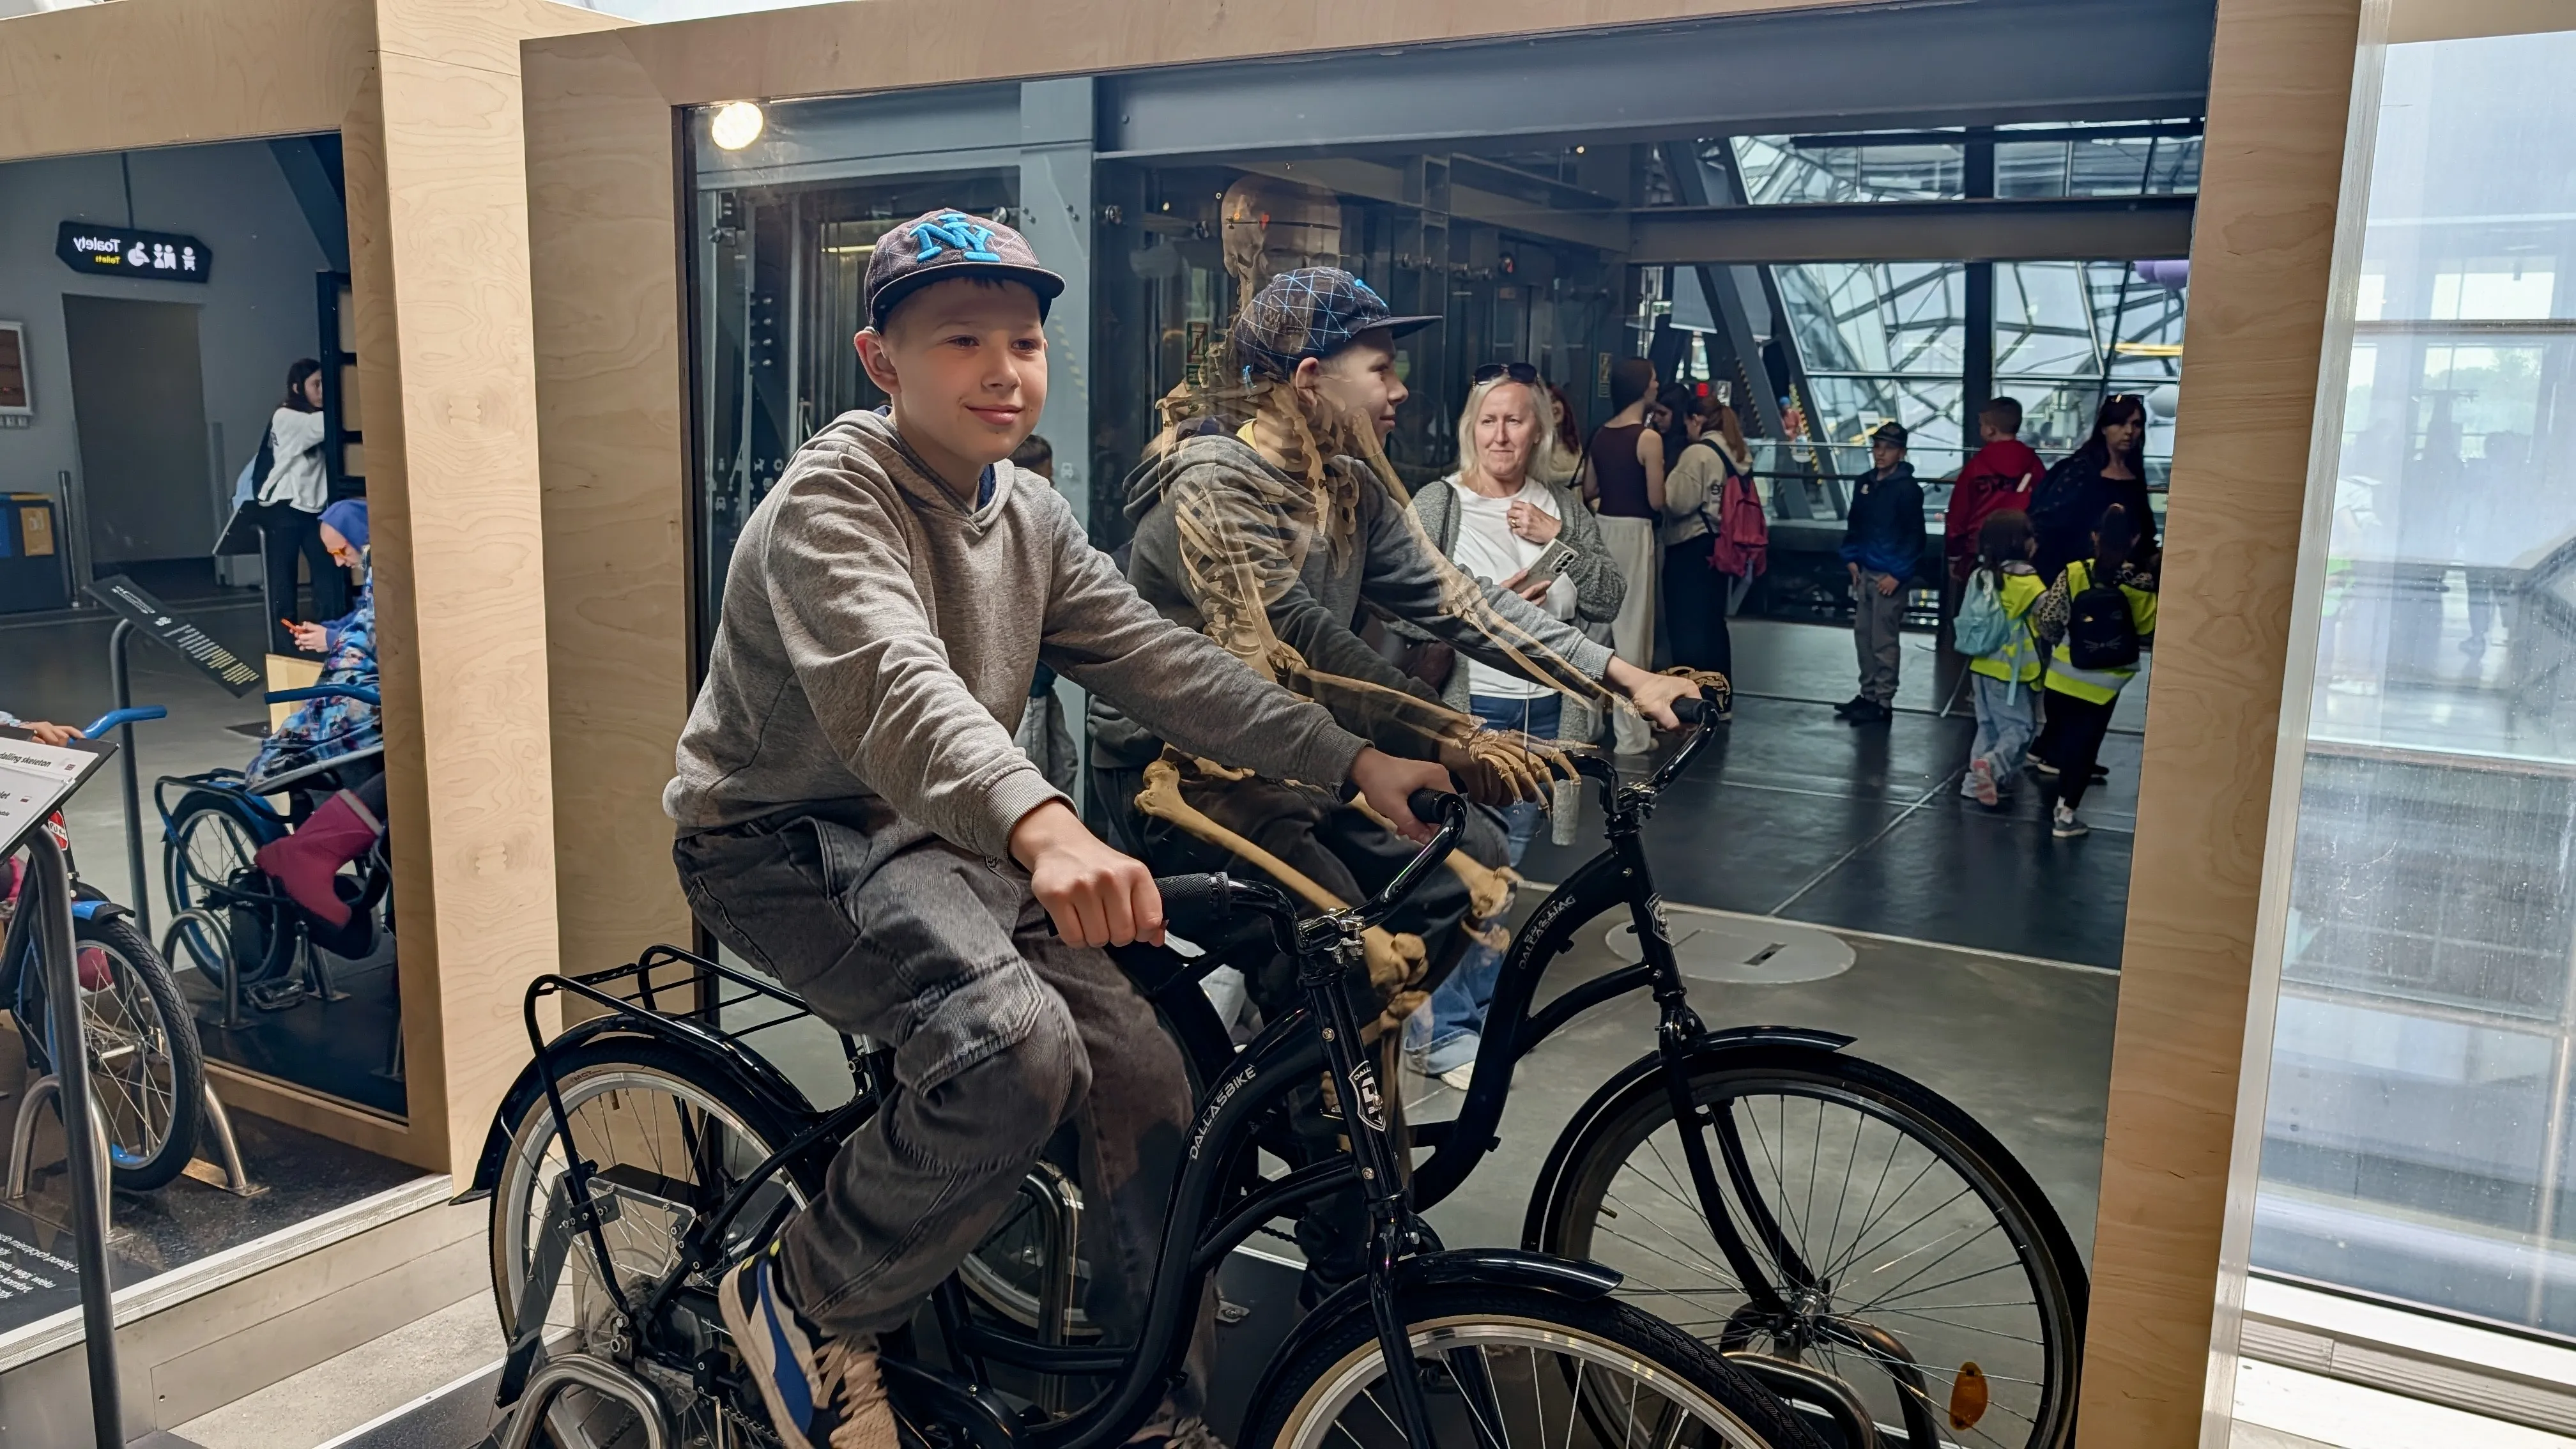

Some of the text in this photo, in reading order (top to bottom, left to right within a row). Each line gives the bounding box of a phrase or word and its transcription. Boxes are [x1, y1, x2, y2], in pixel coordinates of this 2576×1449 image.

[909, 213, 1000, 263] NY
[20, 756, 51, 767] skeleton
[1189, 1065, 1257, 1160] DALLASBIKE
